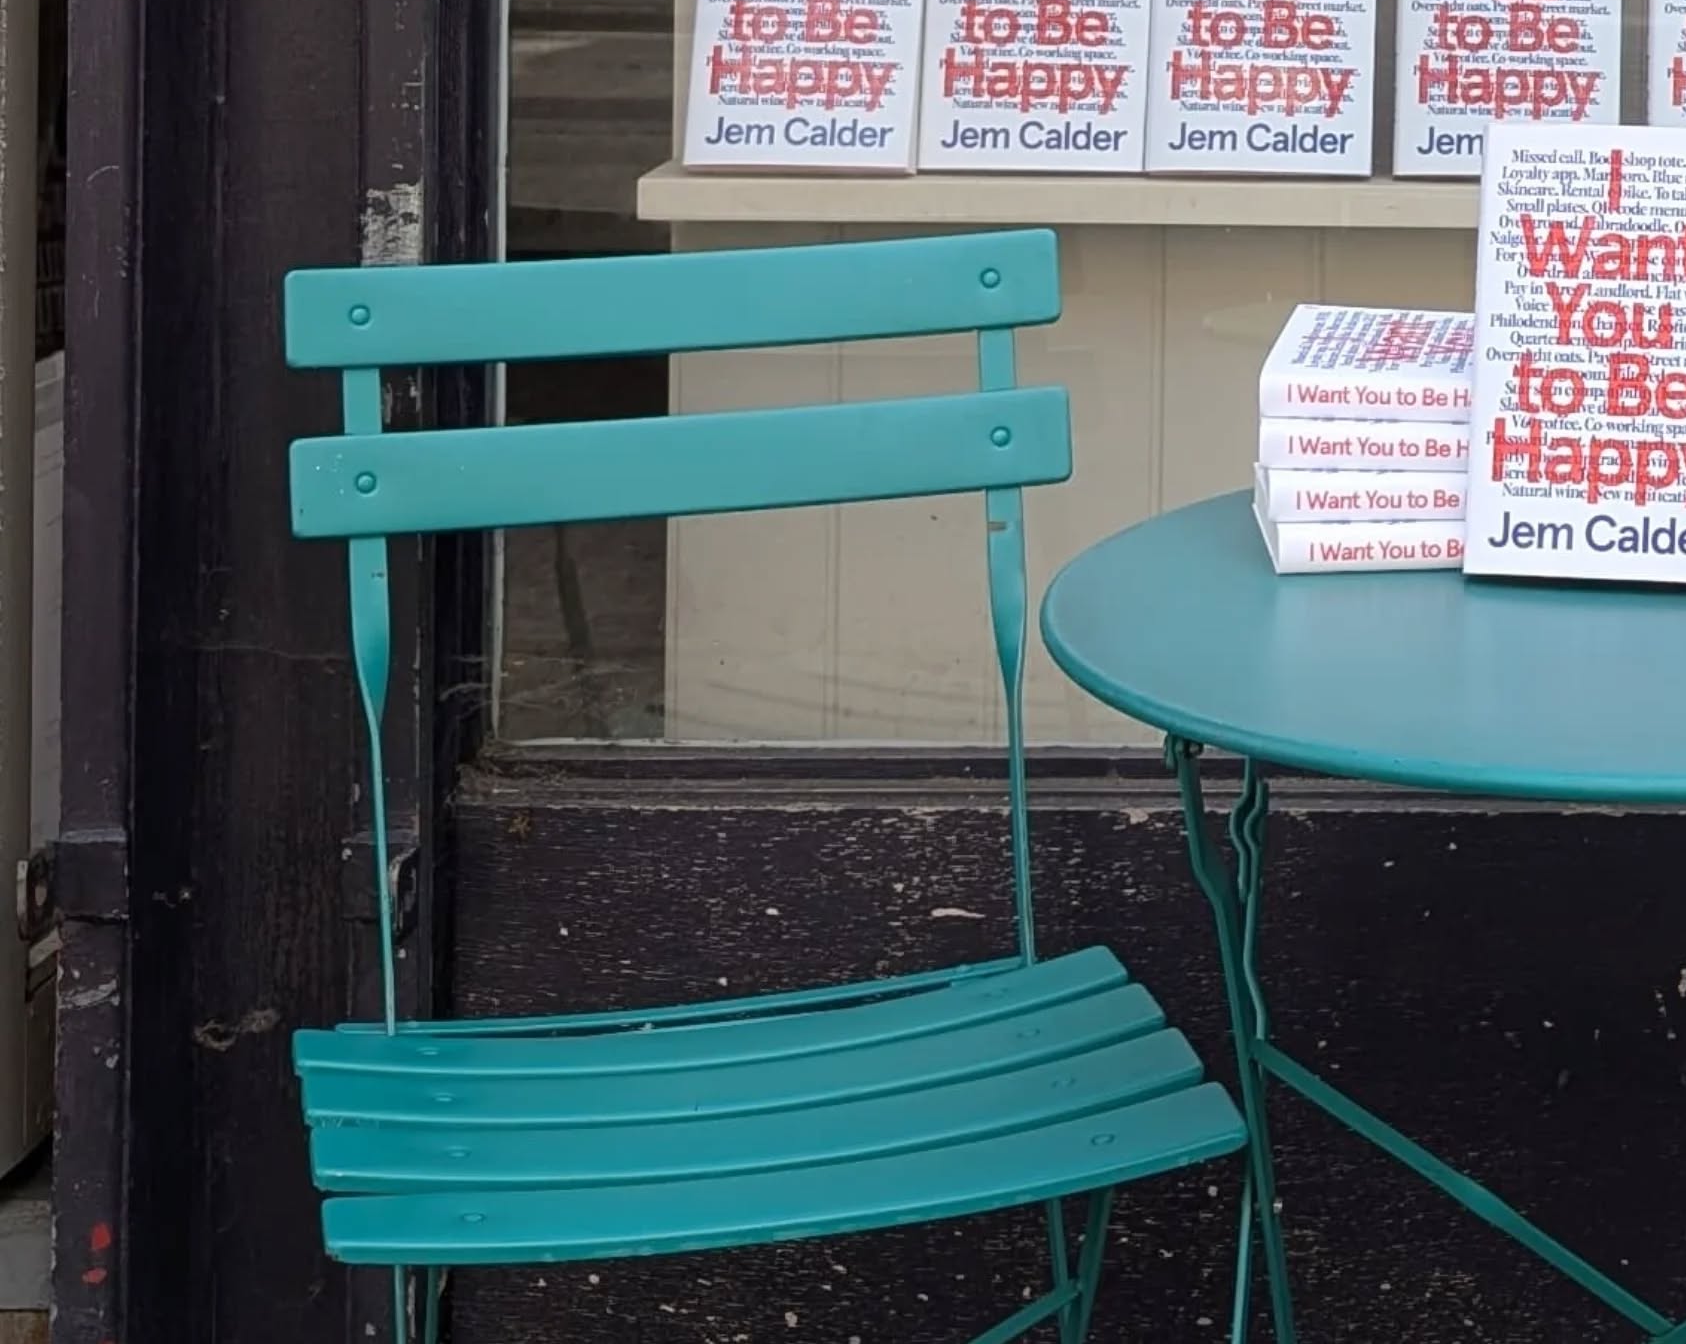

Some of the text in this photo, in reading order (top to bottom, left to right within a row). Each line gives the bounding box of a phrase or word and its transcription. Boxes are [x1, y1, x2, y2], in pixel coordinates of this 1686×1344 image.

[1435, 3, 1581, 54] to Be
[708, 44, 898, 113] Happy
[941, 47, 1130, 115] Happy
[1415, 54, 1600, 121] Happy
[705, 116, 894, 149] Jem Calder
[941, 120, 1129, 153] Jem Calder
[1610, 150, 1623, 215] I
[1545, 283, 1674, 351] You
[1287, 384, 1292, 403] I
[1297, 385, 1351, 405] Want
[1355, 386, 1391, 406] You
[1396, 388, 1417, 406] to
[1422, 388, 1449, 407] Be
[1512, 351, 1586, 417] to
[1288, 436, 1293, 455] I
[1299, 437, 1352, 457] Want
[1356, 438, 1394, 457] You
[1399, 439, 1420, 458] to
[1425, 439, 1452, 458] Be
[1296, 490, 1460, 511] I Want You to Be
[1487, 511, 1573, 552] Jem
